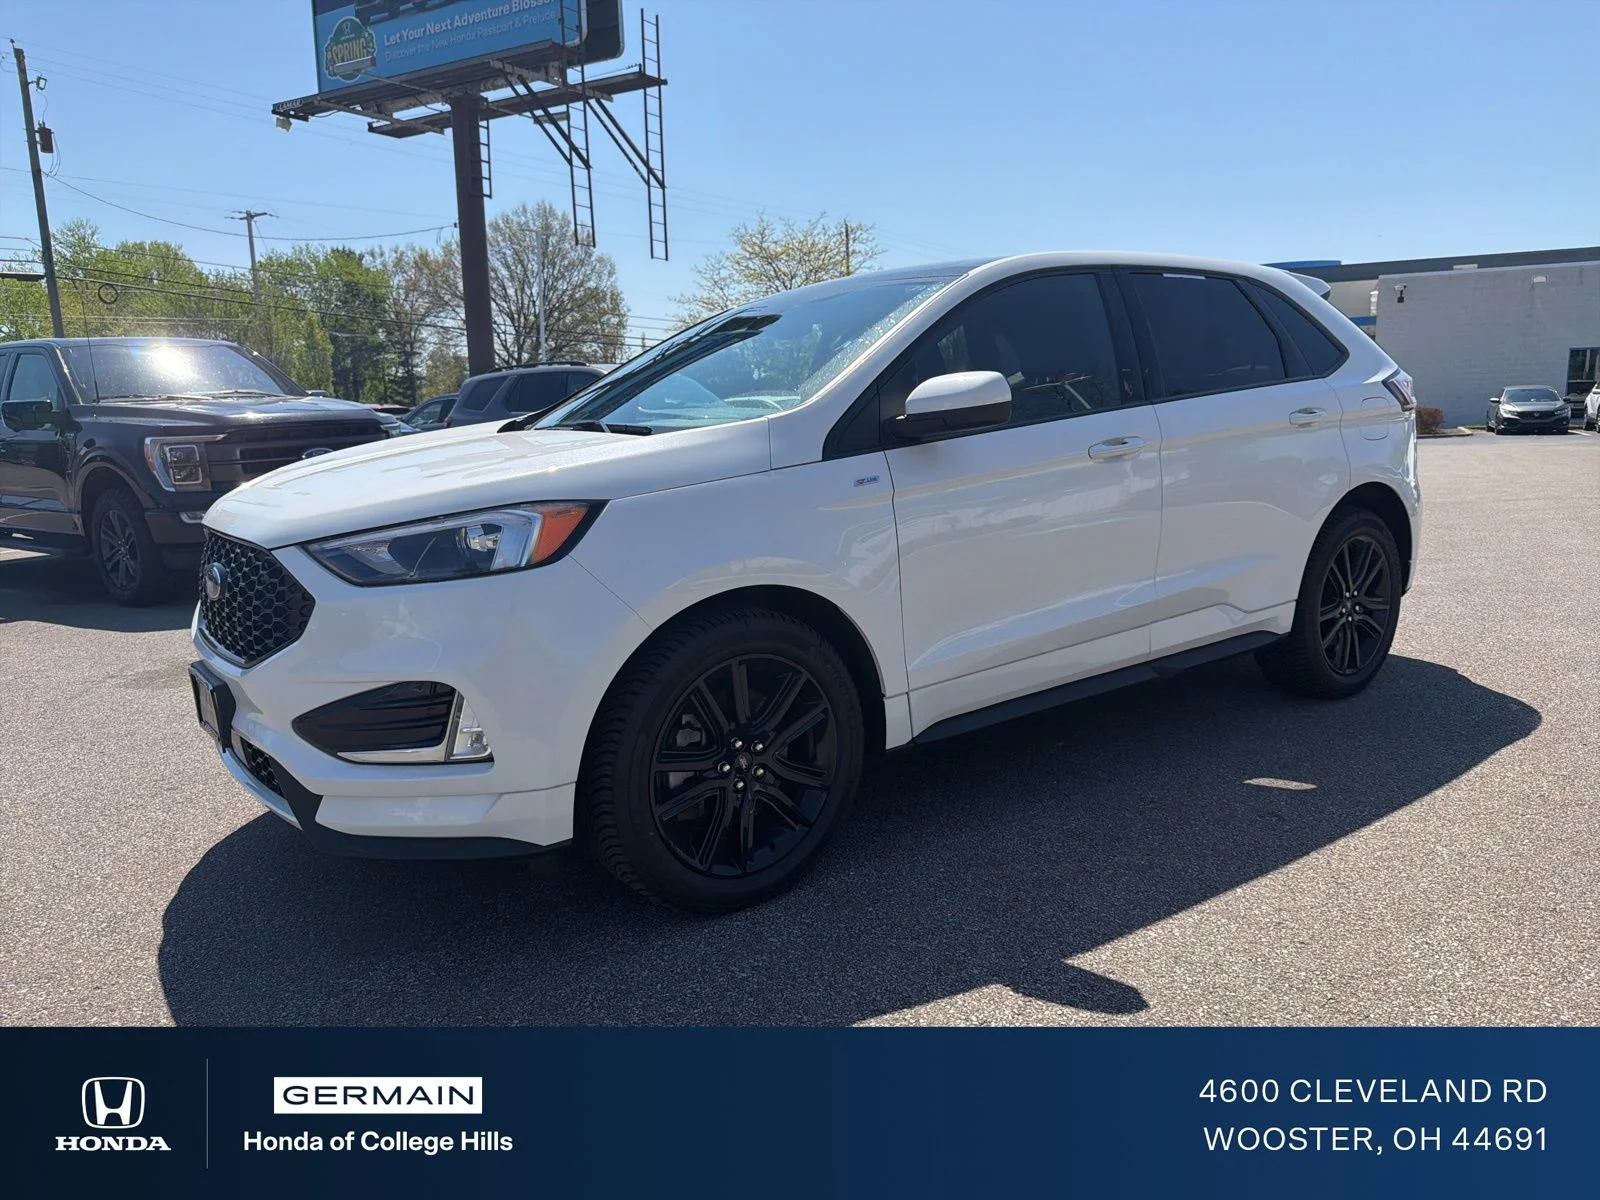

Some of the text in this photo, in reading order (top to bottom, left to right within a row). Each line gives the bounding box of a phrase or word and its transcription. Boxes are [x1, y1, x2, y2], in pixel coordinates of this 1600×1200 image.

[384, 33, 400, 46] Let
[402, 27, 425, 41] Your
[425, 19, 453, 35] Next
[454, 4, 510, 28] Adventure
[384, 45, 417, 62] Discover
[450, 29, 477, 45] Honda
[478, 20, 513, 37] Passport
[515, 16, 522, 28] &
[523, 10, 557, 26] Prelude
[331, 38, 368, 65] SPRING
